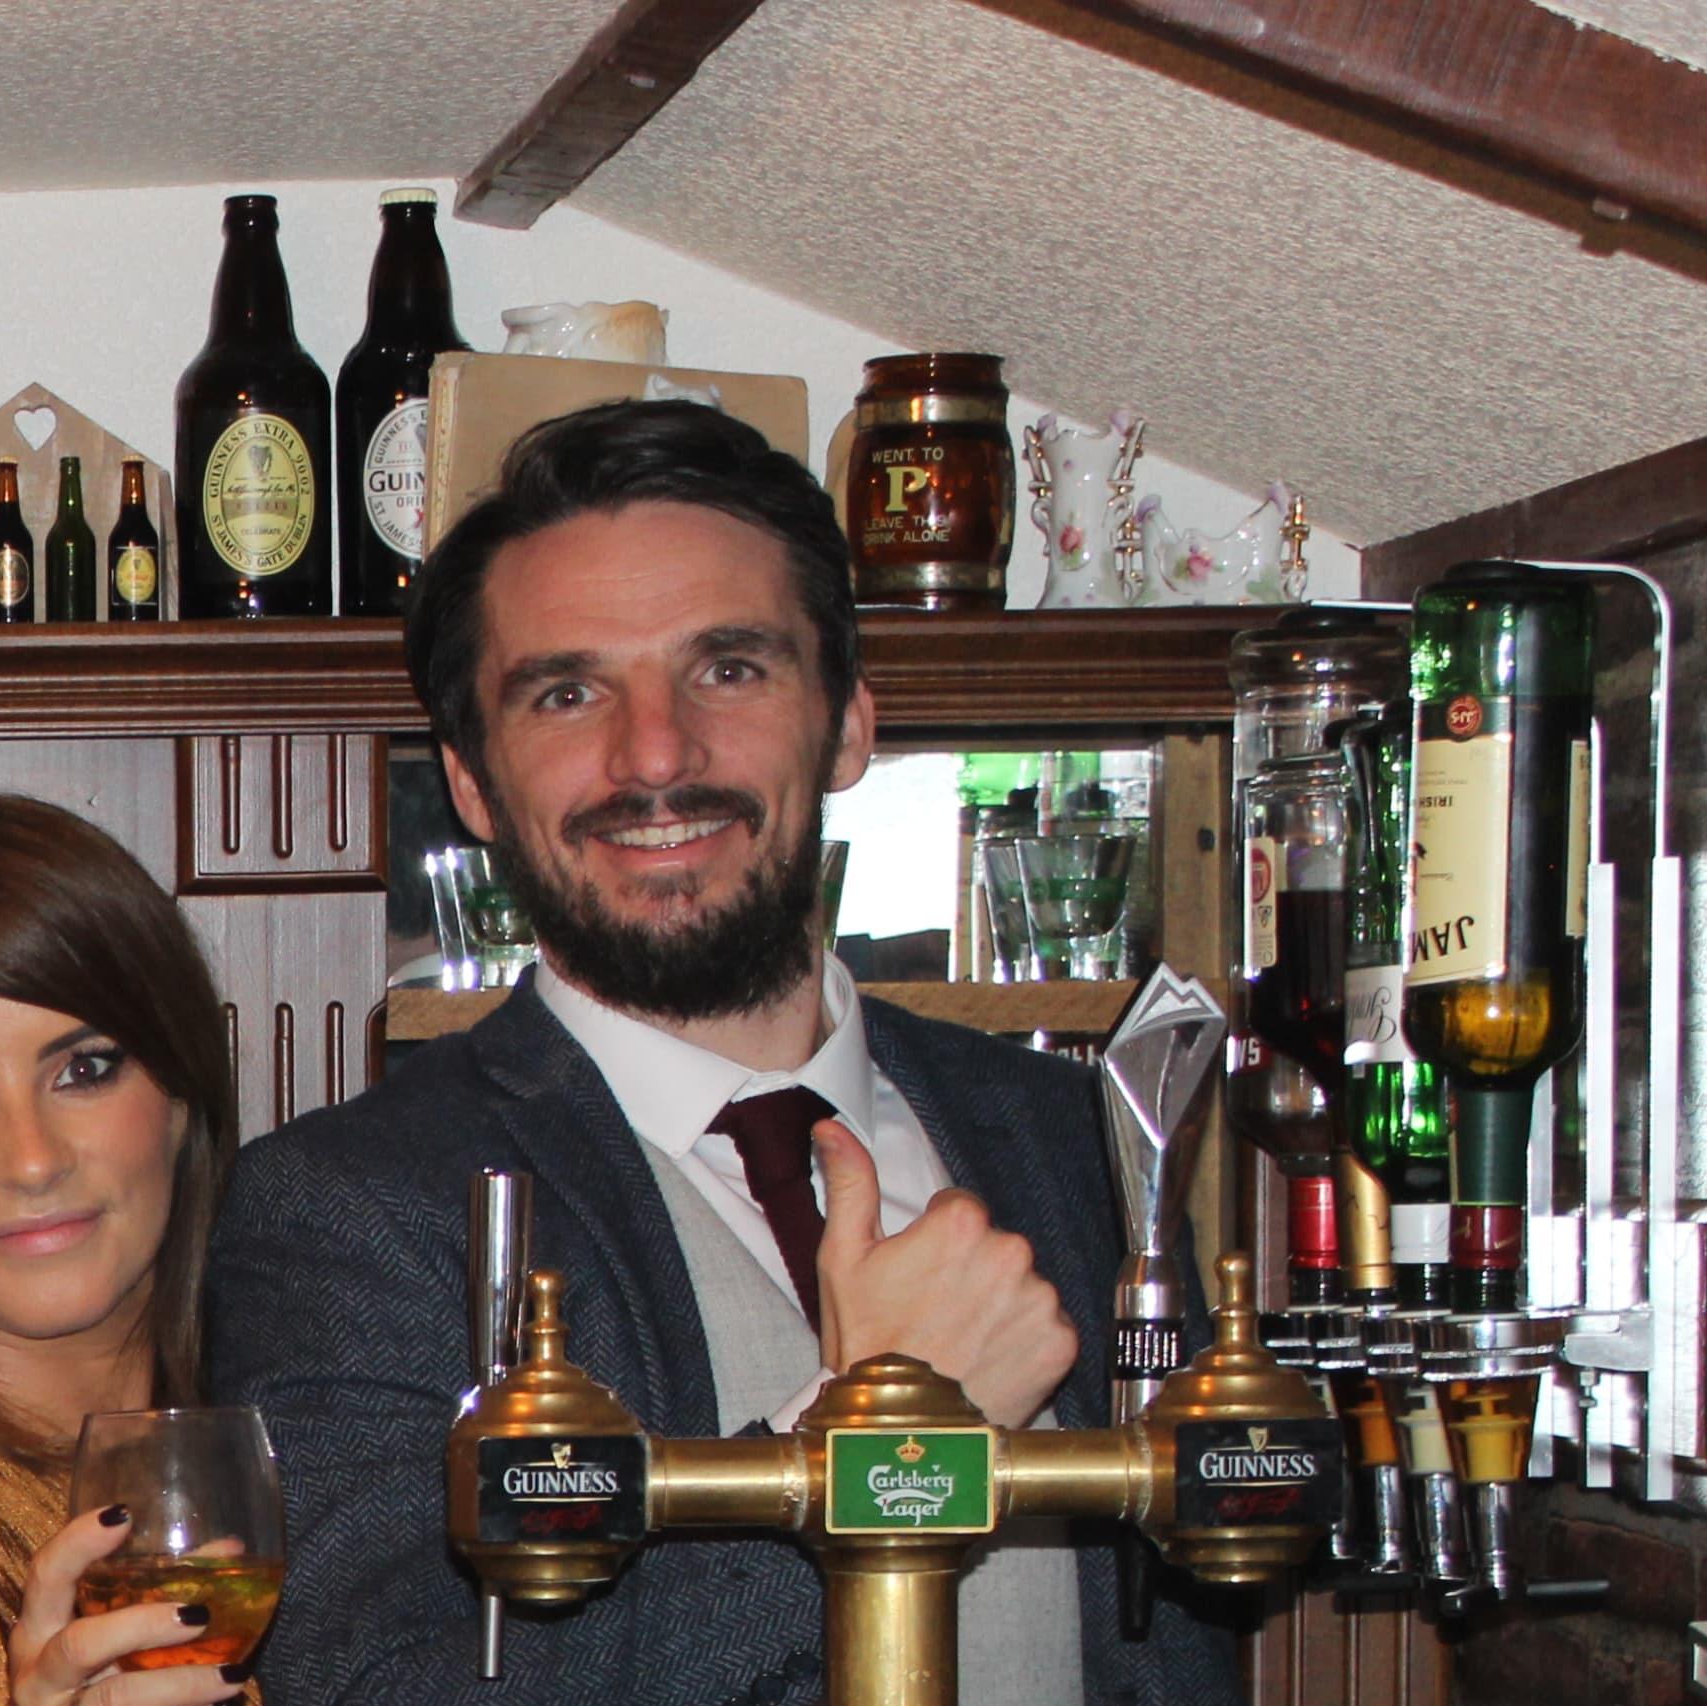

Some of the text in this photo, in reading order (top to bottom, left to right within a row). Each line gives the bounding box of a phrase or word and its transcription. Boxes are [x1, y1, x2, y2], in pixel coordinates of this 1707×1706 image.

[374, 412, 417, 464] GUINNESS
[211, 428, 248, 498] GUINNESS
[254, 422, 294, 450] EXTRA
[872, 447, 944, 464] WENT TO
[369, 470, 425, 492] GUIN
[885, 466, 928, 512] P
[864, 516, 904, 531] LEAVE
[864, 529, 950, 545] DRINK ALONE
[1410, 915, 1475, 964] JAM
[1199, 1452, 1315, 1479] GUINNESS
[503, 1467, 618, 1494] GUINNESS
[867, 1464, 954, 1498] Carlsberg
[881, 1503, 944, 1527] Lager
